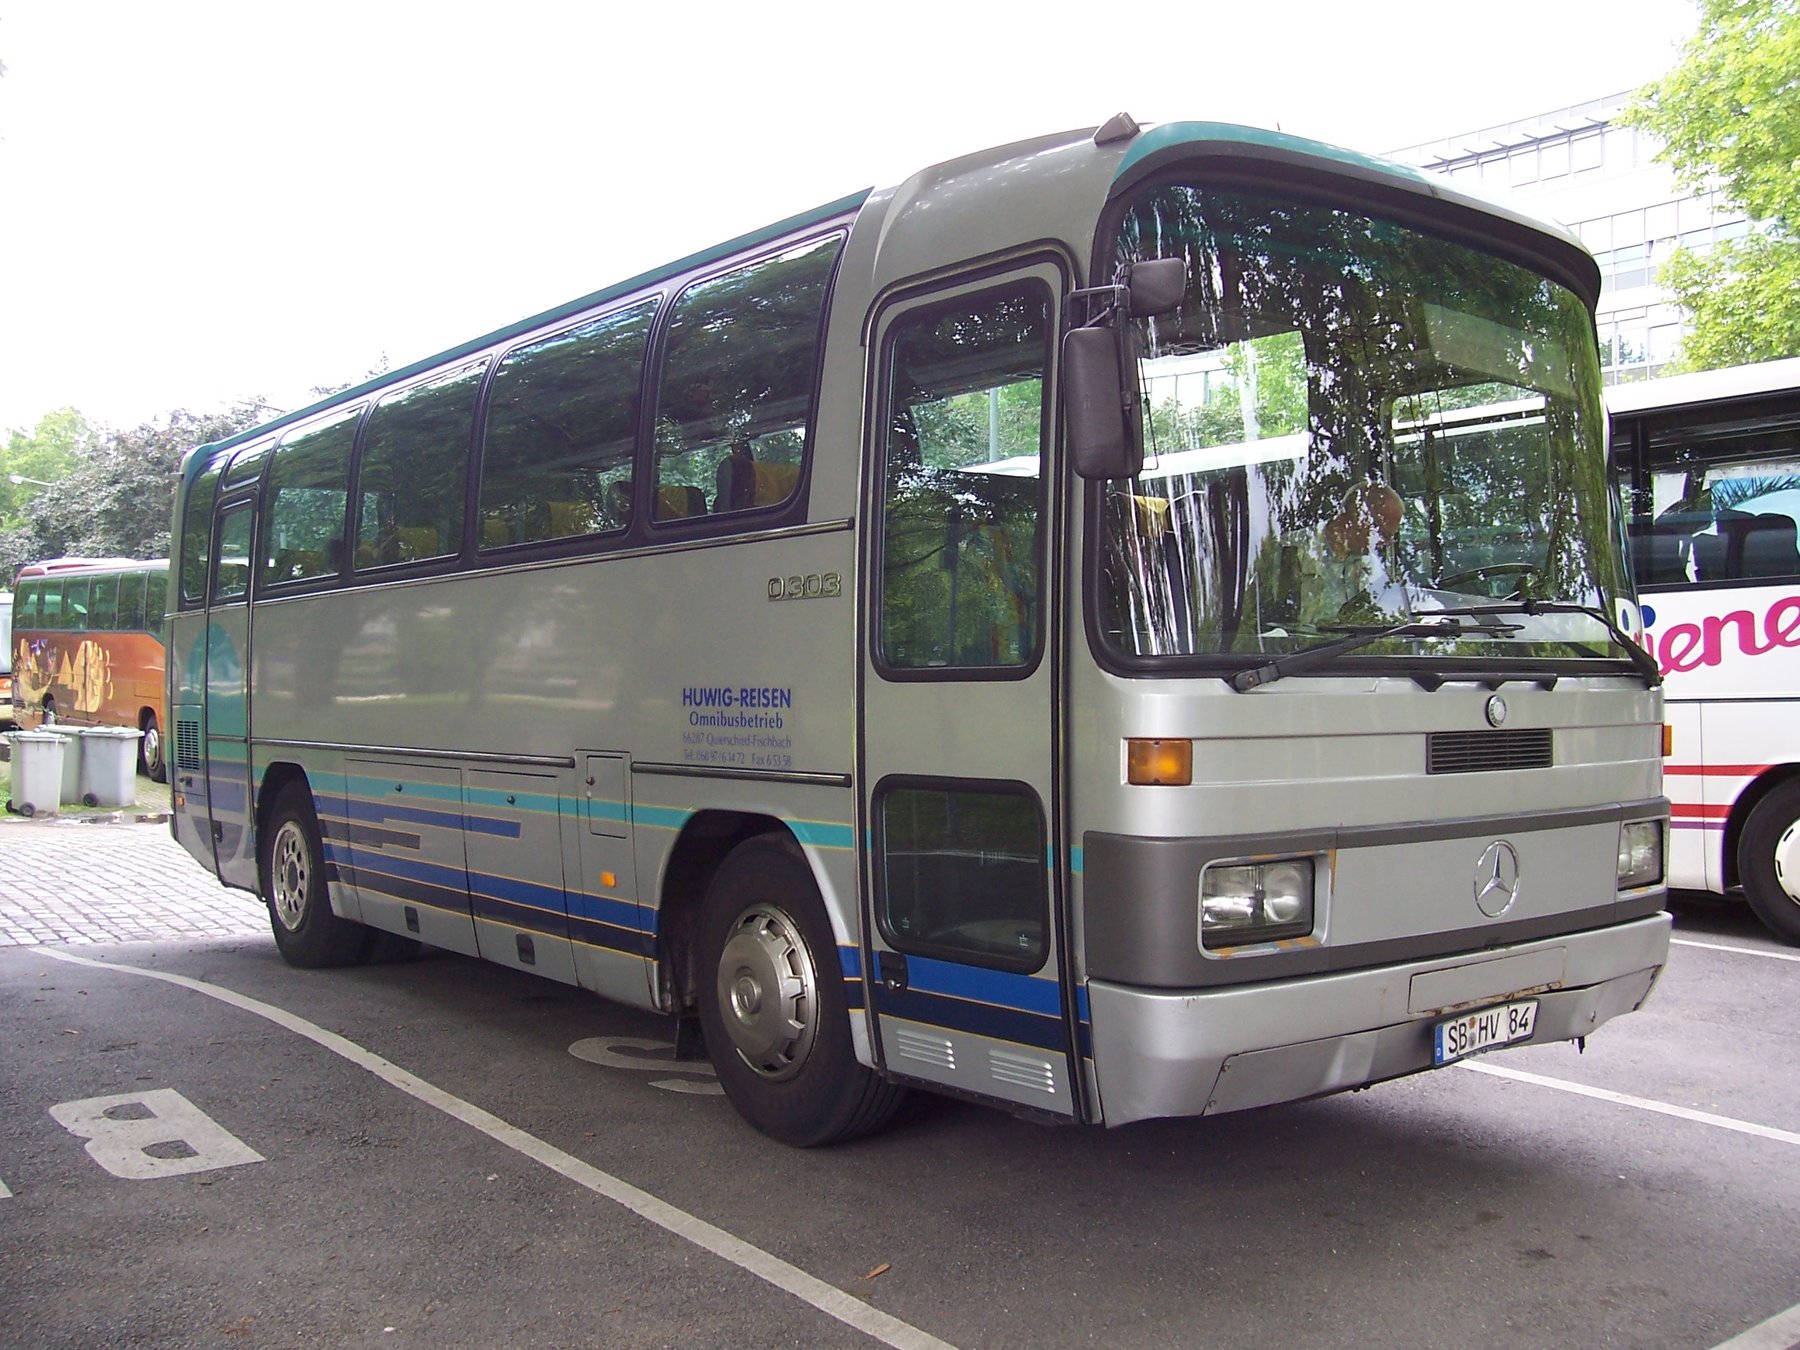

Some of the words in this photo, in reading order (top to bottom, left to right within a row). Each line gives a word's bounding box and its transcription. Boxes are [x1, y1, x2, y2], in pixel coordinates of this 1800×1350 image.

[682, 687, 791, 709] HUWIG-REISEN
[689, 711, 783, 729] Omnibusbetrieb
[1448, 1022, 1467, 1054] SB
[1478, 1012, 1500, 1044] HV
[1509, 1006, 1530, 1035] 84
